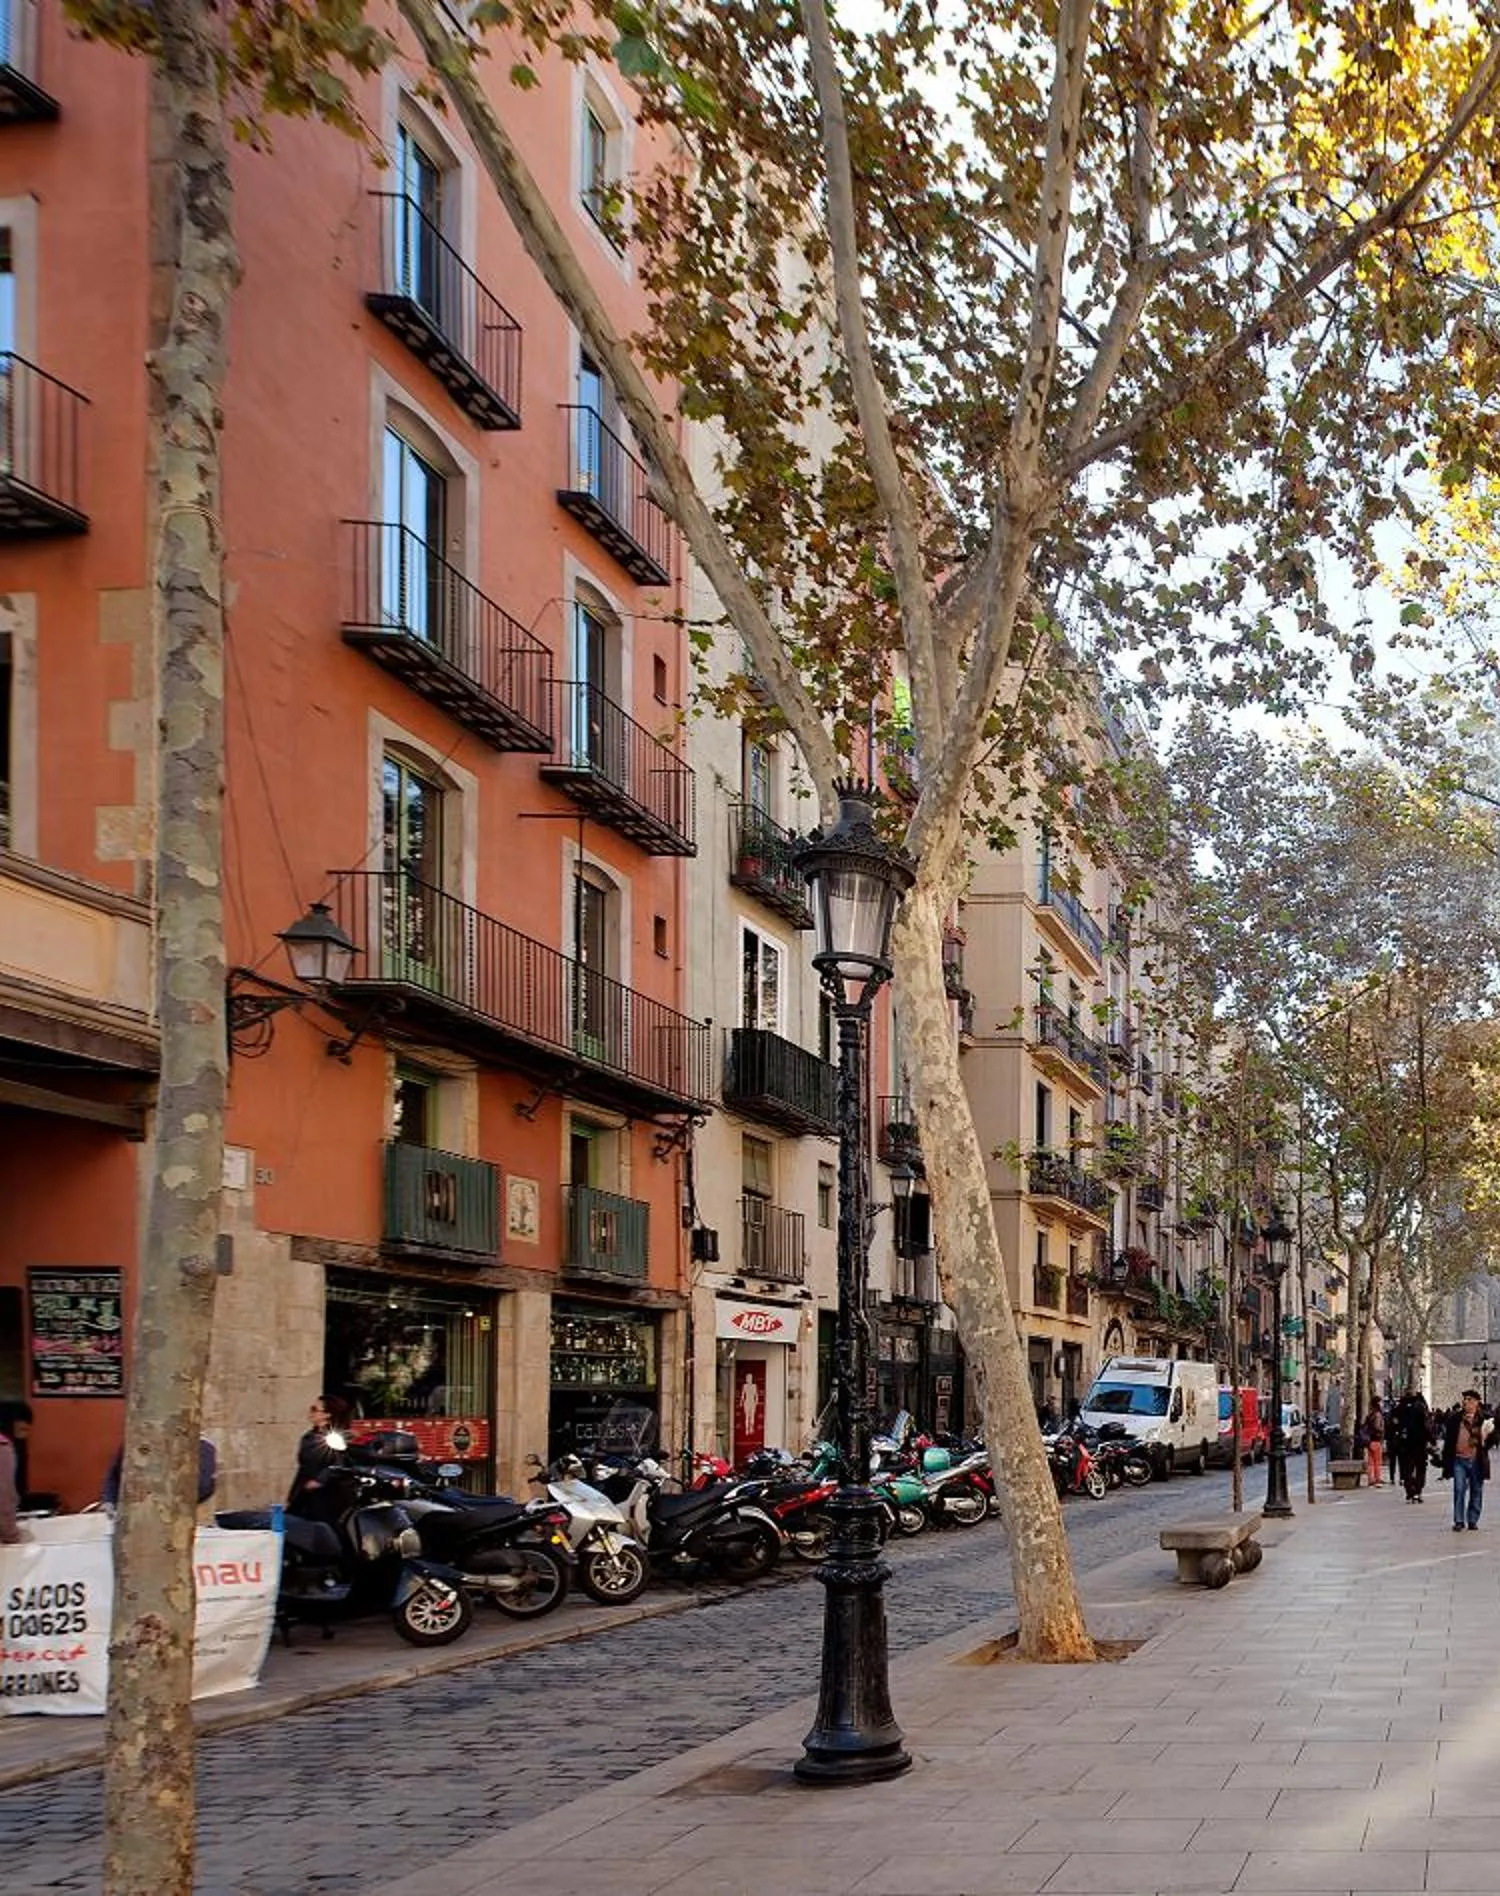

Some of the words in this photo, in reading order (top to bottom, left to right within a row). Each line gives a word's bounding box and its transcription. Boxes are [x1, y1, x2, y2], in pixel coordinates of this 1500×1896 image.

[740, 1314, 775, 1331] MBT
[195, 1561, 262, 1587] nau
[8, 1582, 85, 1611] SACOS
